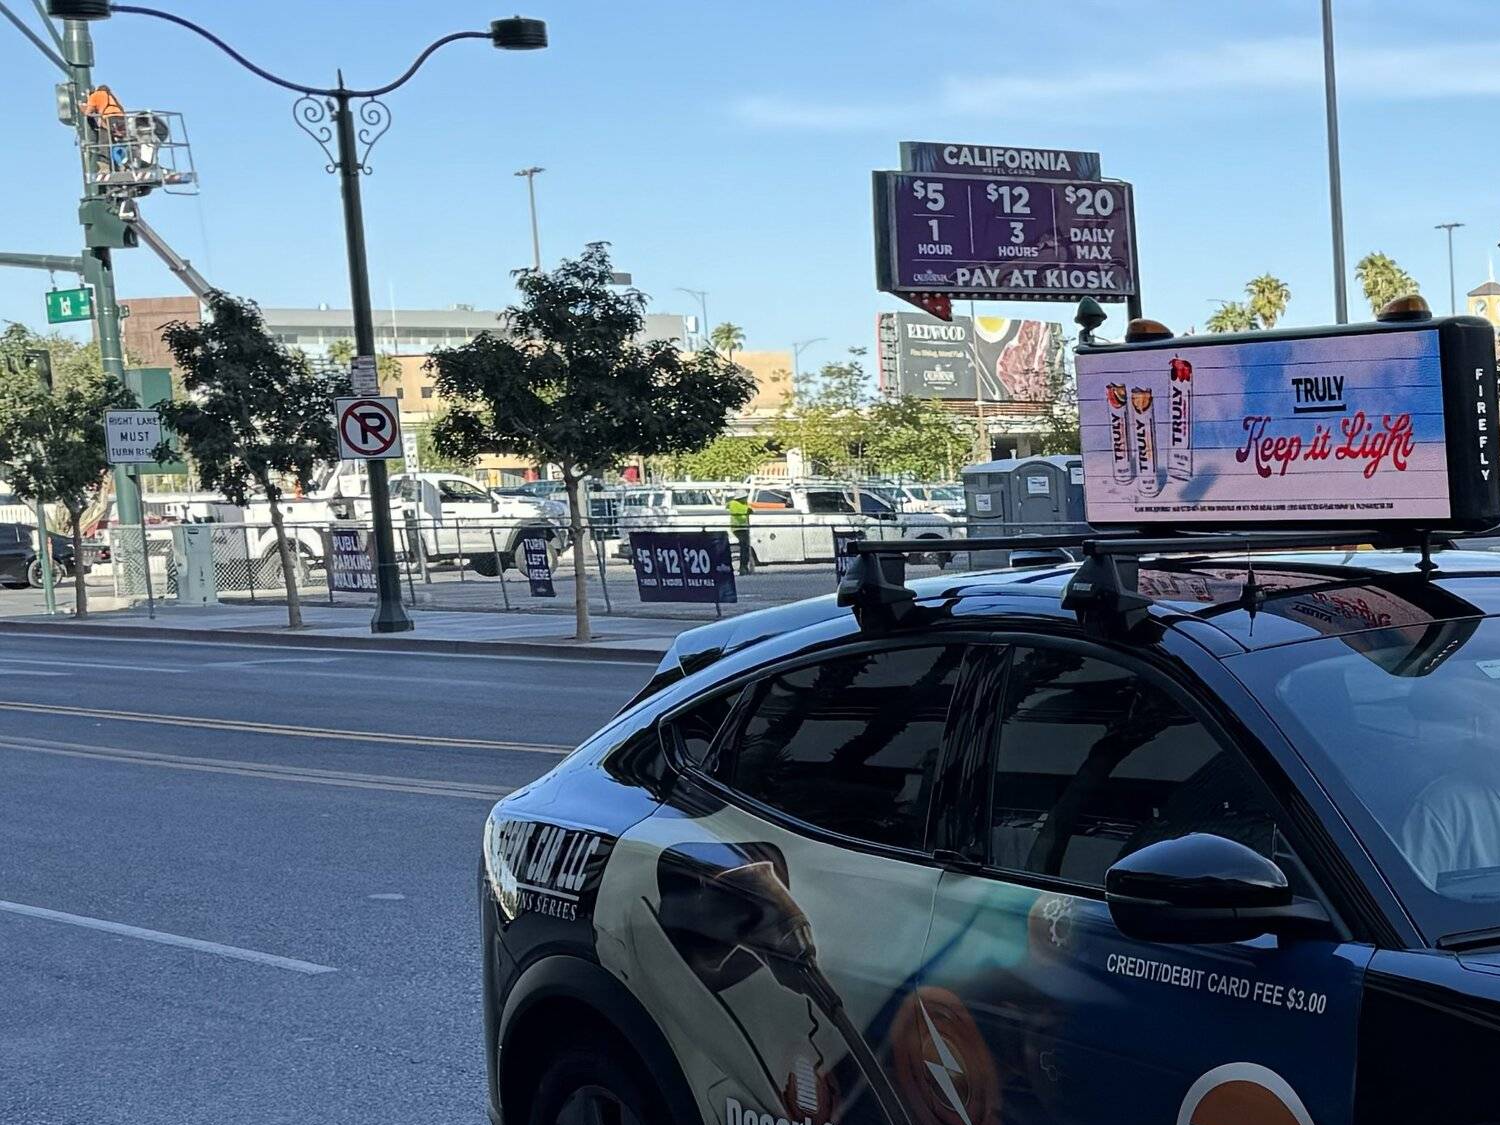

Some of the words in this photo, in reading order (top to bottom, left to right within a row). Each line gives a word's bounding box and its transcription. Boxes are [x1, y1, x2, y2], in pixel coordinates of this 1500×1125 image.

[943, 145, 1072, 172] CALIFORNIA
[913, 179, 945, 212] $5
[986, 182, 1031, 215] $12
[1064, 185, 1115, 217] $20
[927, 218, 940, 242] 1
[1009, 221, 1025, 244] 3
[1070, 227, 1115, 243] DAILY
[918, 243, 953, 256] HOUR
[998, 246, 1039, 258] HOURS
[1075, 245, 1112, 260] MAX
[956, 267, 1000, 287] PAY
[1009, 268, 1038, 288] AT
[1046, 269, 1116, 289] KIOSK
[906, 323, 966, 341] REDWOOD
[1291, 375, 1345, 403] TRULY
[109, 416, 133, 426] RIGHT
[1172, 385, 1183, 446] TRULY
[1475, 368, 1490, 481] FIREFLY
[120, 431, 150, 442] MUST
[1111, 412, 1124, 463] TRULY
[1136, 418, 1149, 473] TRULY
[1235, 415, 1303, 479] Keep
[1303, 424, 1333, 460] it
[1335, 411, 1416, 479] Light
[111, 447, 134, 457] TURN
[524, 537, 548, 551] TURN
[332, 554, 372, 571] PARKING
[527, 554, 547, 566] LEFT
[637, 547, 653, 574] $5
[656, 548, 681, 574] $12
[683, 547, 711, 574] $20
[333, 571, 377, 589] AVAILABLE
[529, 568, 550, 581] HERE
[526, 825, 566, 884] CAB
[557, 832, 601, 892] LLC
[534, 895, 578, 922] SERIES
[1106, 952, 1205, 991] CREDIT/DEBIT
[1207, 973, 1250, 999] CARD
[1253, 982, 1284, 1007] FEE
[1286, 986, 1327, 1015] $3.00
